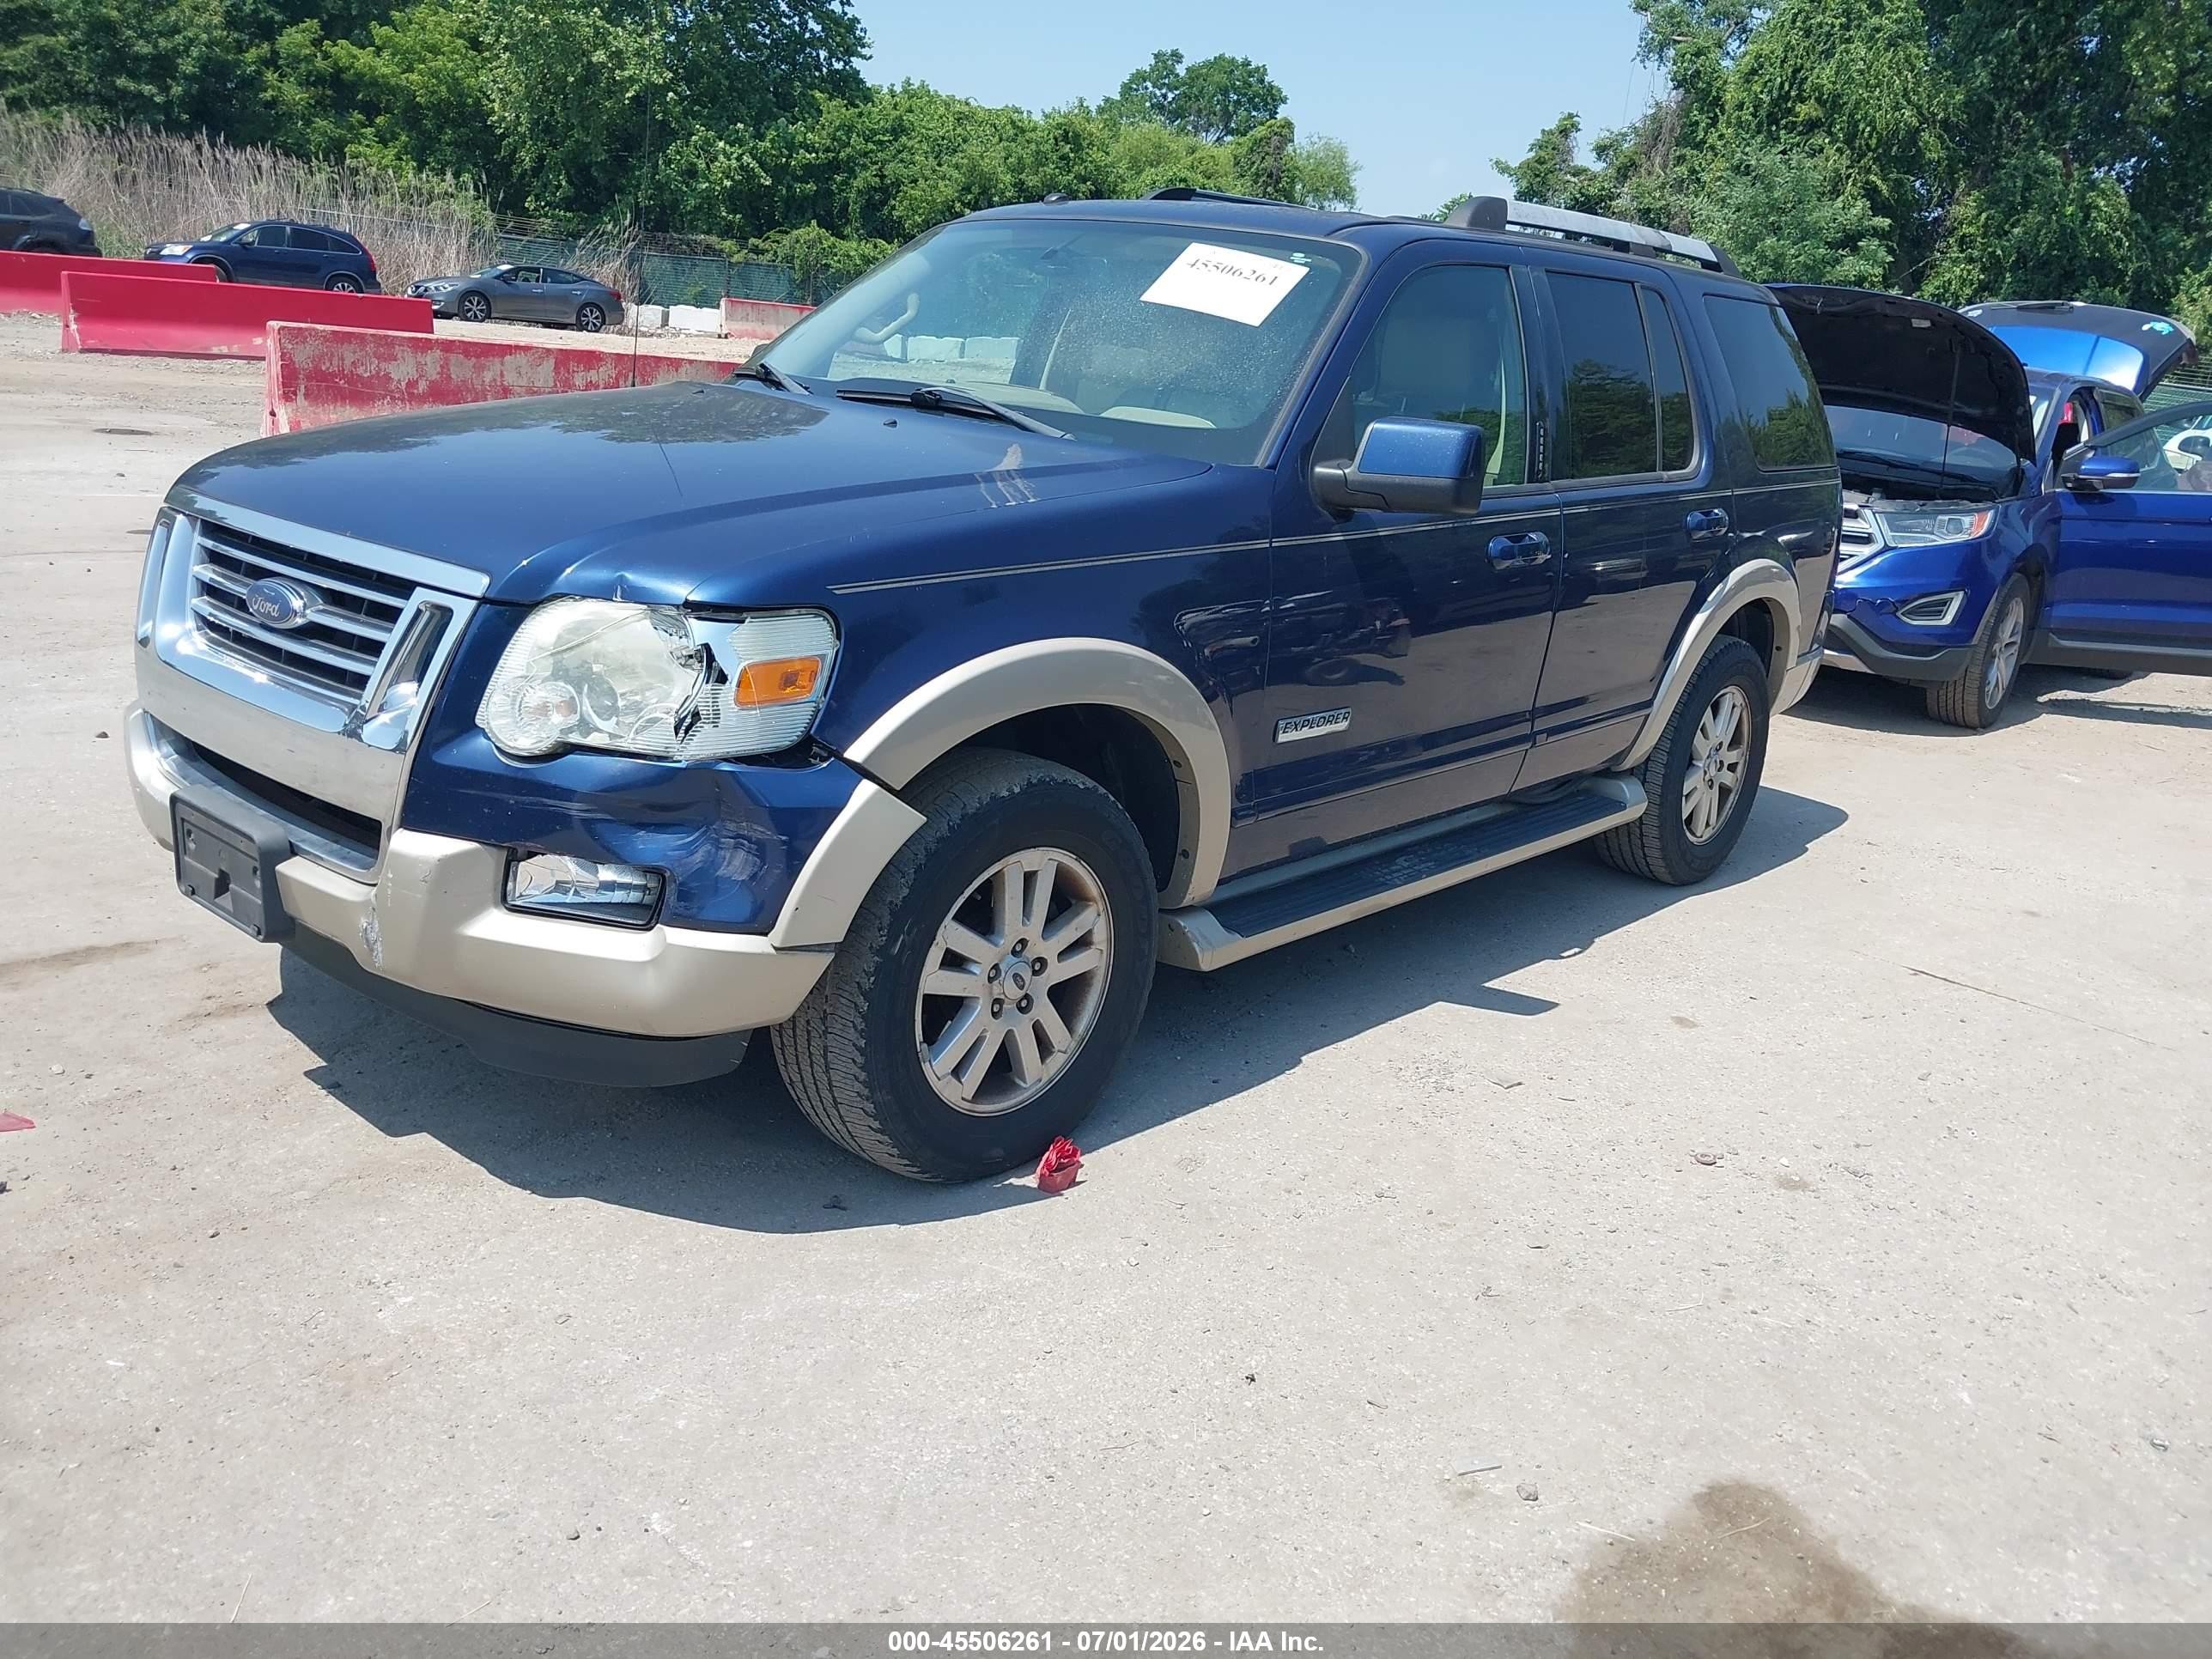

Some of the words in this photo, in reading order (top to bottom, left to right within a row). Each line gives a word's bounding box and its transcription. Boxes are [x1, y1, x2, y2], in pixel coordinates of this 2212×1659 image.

[1186, 258, 1279, 286] 45506261
[252, 594, 282, 617] Ford
[1281, 711, 1351, 734] EXPLORER
